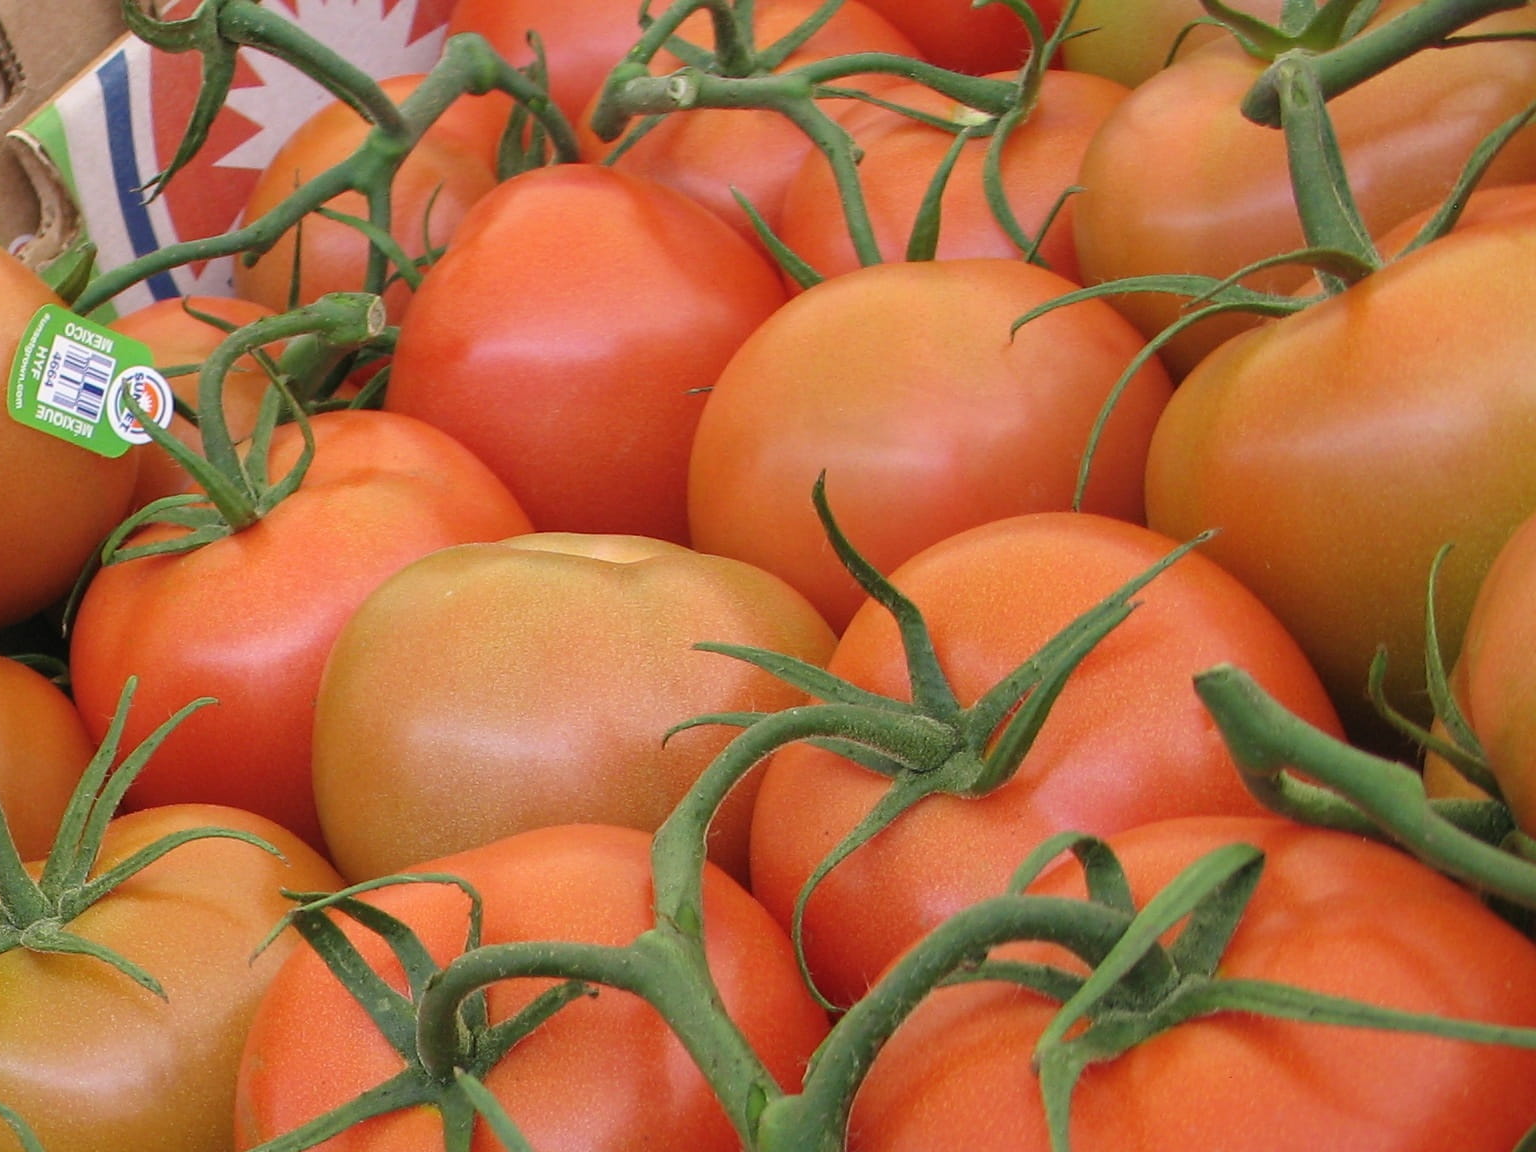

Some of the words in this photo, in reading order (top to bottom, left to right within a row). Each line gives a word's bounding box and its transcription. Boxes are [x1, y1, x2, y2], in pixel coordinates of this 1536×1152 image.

[65, 322, 114, 353] MEXICO
[44, 351, 62, 388] 4664
[118, 372, 145, 433] SUNET
[35, 404, 94, 439] MÉXIQUE
